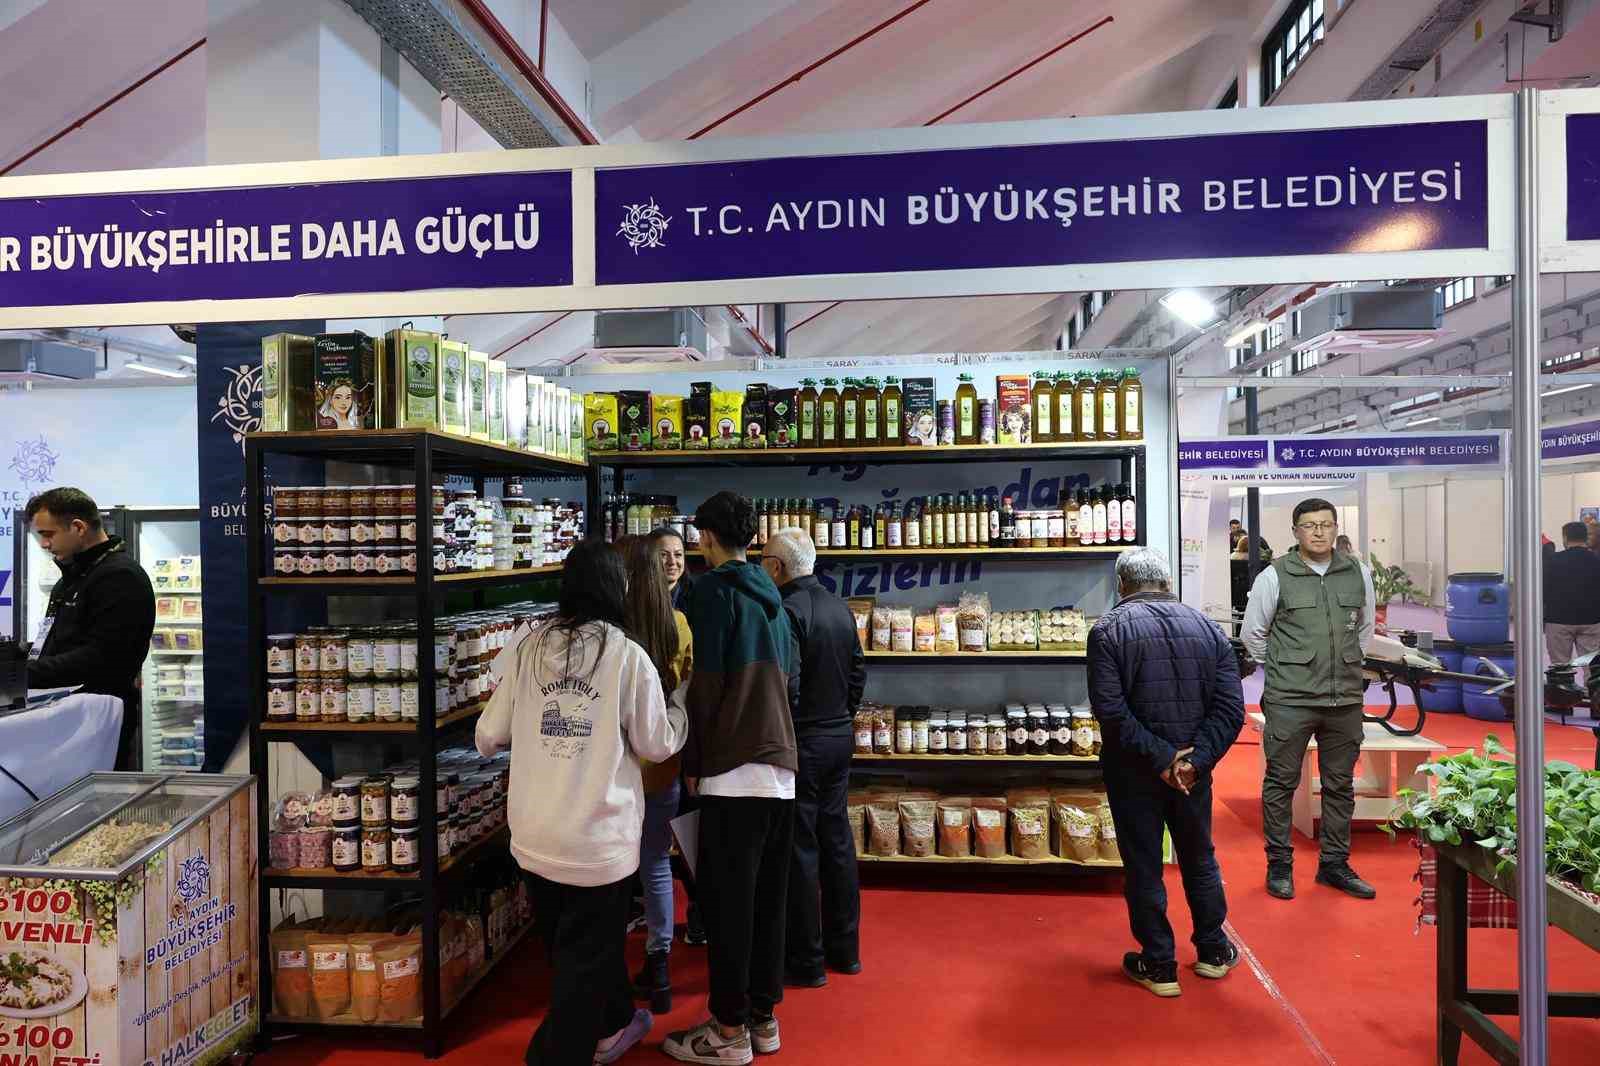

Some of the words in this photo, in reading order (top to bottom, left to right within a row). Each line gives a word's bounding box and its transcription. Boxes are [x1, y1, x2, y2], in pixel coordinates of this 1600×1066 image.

[686, 204, 754, 236] T.C.
[765, 197, 886, 232] AYDIN
[908, 177, 1182, 227] BÜYÜKŞEHİR
[1203, 161, 1463, 212] BELEDİYESİ
[31, 219, 291, 273] BÜYÜKŞEHİRLE
[302, 219, 405, 258] DAHA
[415, 203, 540, 258] GÜÇLÜ
[1206, 447, 1264, 460] BELEDİYESİ
[1299, 448, 1317, 458] T.C.
[1320, 446, 1352, 458] AYDIN
[1356, 443, 1426, 457] BÜYÜKŞEHİR
[1430, 440, 1493, 456] BELEDİYESİ
[189, 897, 218, 921] AYDIN
[0, 920, 93, 945] VENLİ
[147, 904, 236, 963] BÜYÜKŞEHİR
[164, 932, 223, 971] BELEDİYESİ
